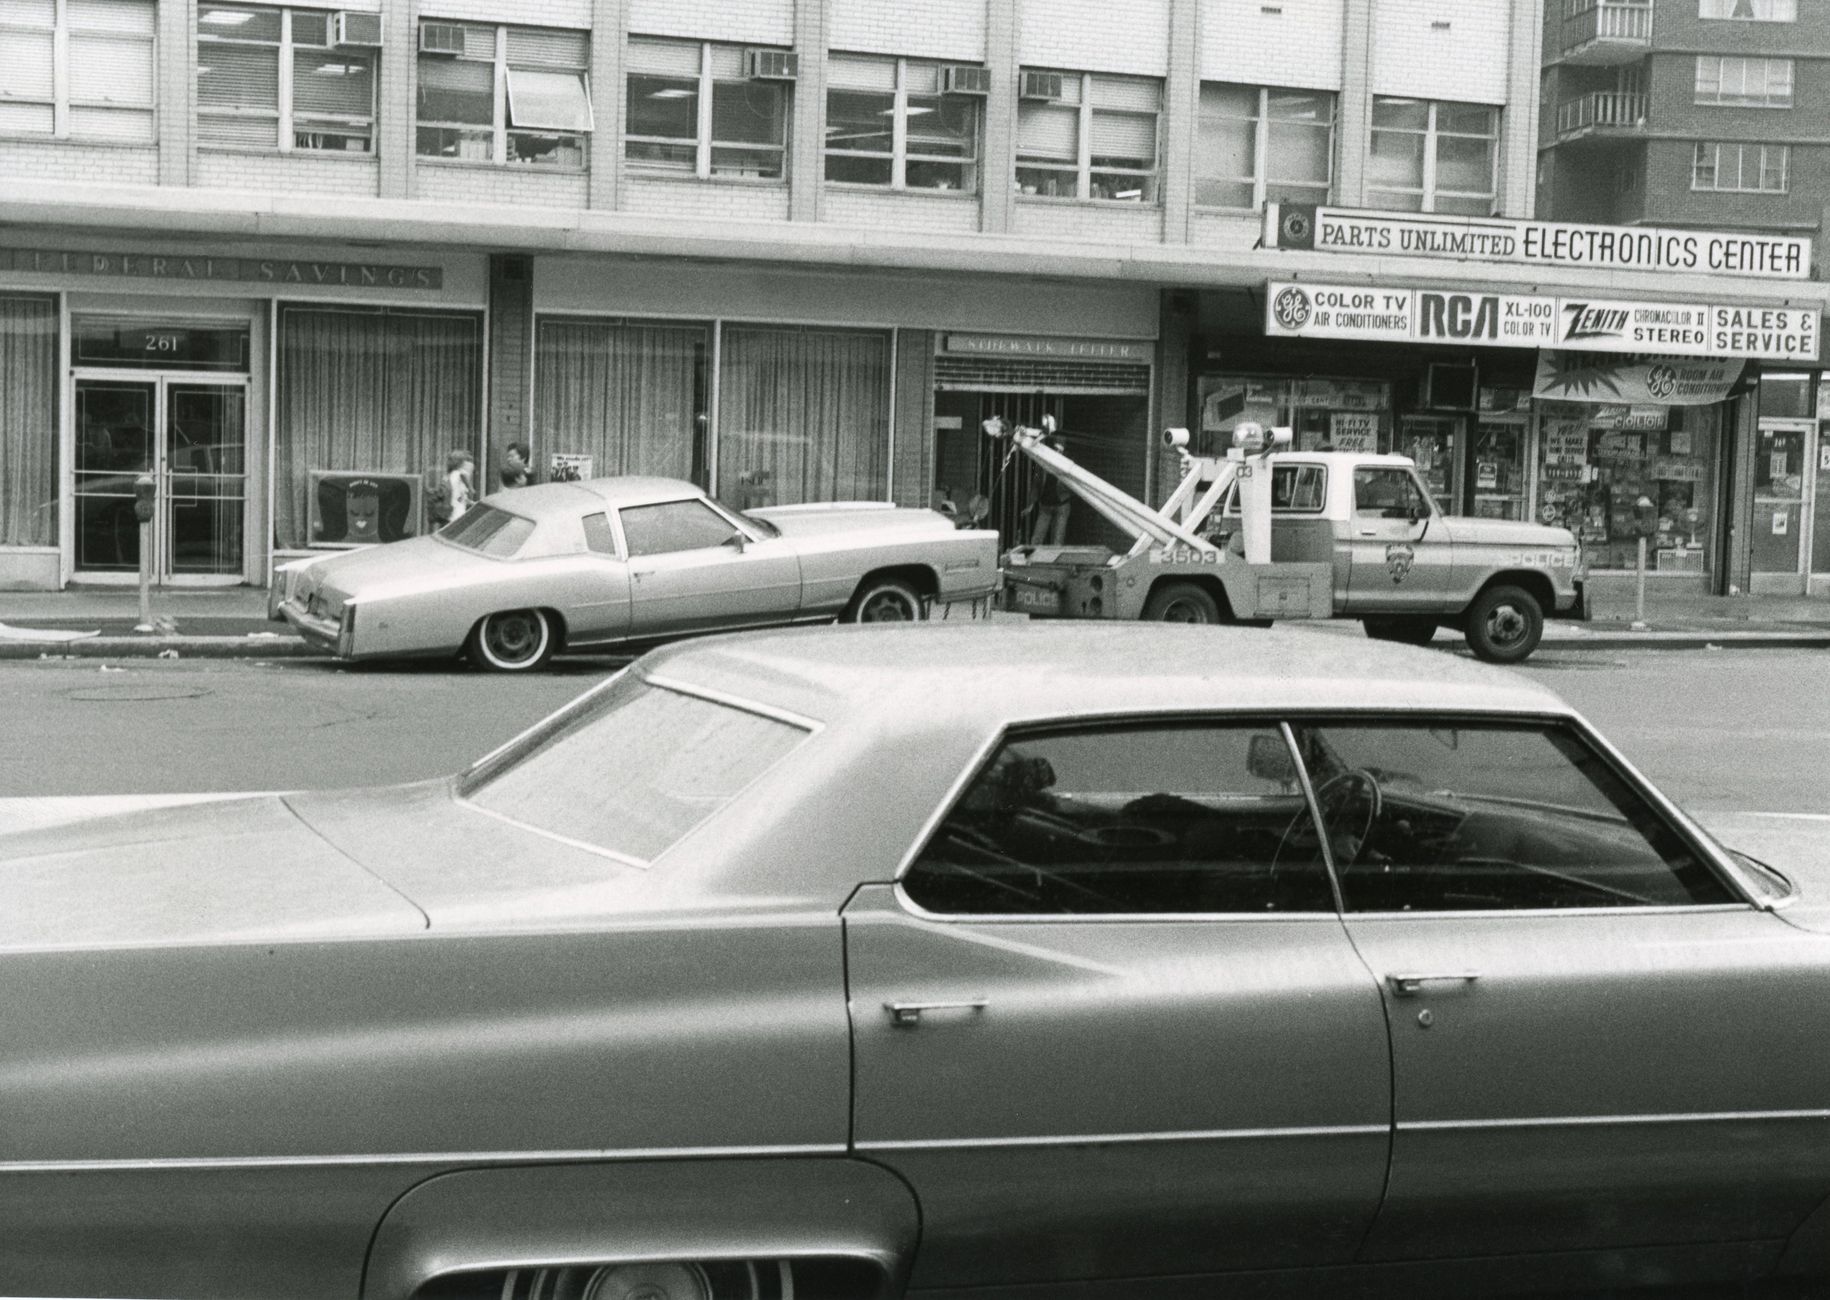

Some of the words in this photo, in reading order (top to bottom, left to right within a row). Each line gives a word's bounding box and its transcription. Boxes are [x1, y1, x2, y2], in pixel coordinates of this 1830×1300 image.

[1320, 223, 1391, 248] PARTS
[1399, 228, 1516, 257] UNLIMITED
[1522, 227, 1698, 268] ELECTRONICS
[1708, 238, 1802, 274] CENTER
[260, 261, 432, 287] SAVINGS
[1314, 291, 1375, 310] COLOR
[1383, 295, 1408, 311] TV
[1420, 293, 1500, 340] RCA
[1505, 301, 1552, 319] XL-100
[1313, 311, 1331, 328] AIR
[1335, 312, 1408, 330] CONDITIONERS
[1716, 308, 1789, 330] SALES
[1800, 312, 1813, 331] &
[1503, 320, 1535, 337] COLOR
[1540, 321, 1552, 337] TV
[1633, 327, 1705, 344] STEREO
[145, 334, 178, 352] 261
[1716, 331, 1812, 354] SERVICE
[1680, 367, 1708, 381] ROOM
[1709, 368, 1726, 381] AIR
[1615, 414, 1665, 429] COLOR
[1335, 428, 1372, 437] SERVICE
[1338, 437, 1366, 448] FREE
[1235, 465, 1253, 479] 03
[1160, 550, 1218, 564] 3503
[1015, 590, 1059, 606] POLICE
